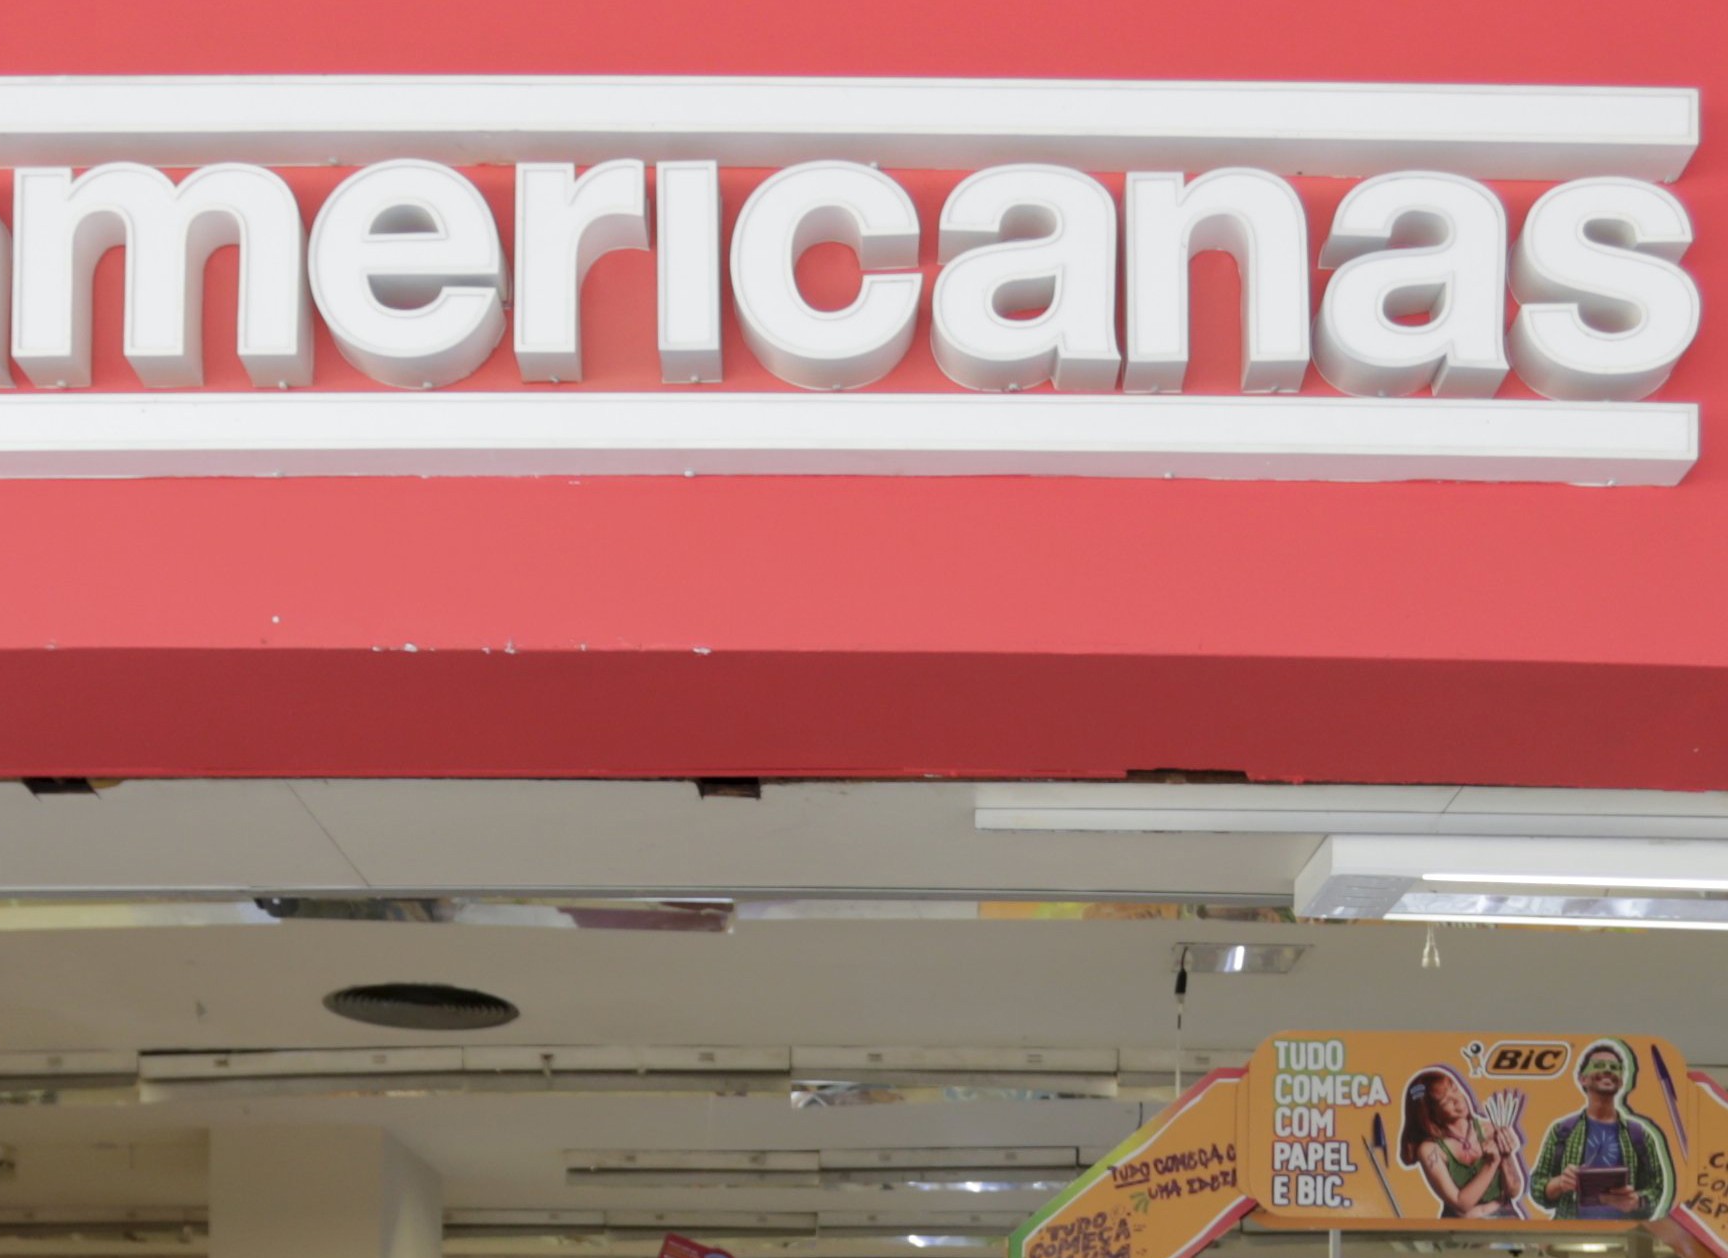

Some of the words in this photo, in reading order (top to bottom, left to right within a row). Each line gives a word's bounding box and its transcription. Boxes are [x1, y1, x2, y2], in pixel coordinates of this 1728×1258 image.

[1274, 1040, 1345, 1071] TUDO
[1274, 1073, 1391, 1107] COMEÇA
[1274, 1106, 1336, 1138] COM
[1109, 1162, 1150, 1181] TUDO
[1272, 1141, 1359, 1173] PAPEL
[1148, 1180, 1181, 1200] UMA
[1272, 1175, 1289, 1207] E
[1296, 1175, 1352, 1208] BIC.
[1047, 1212, 1108, 1241] TUDO
